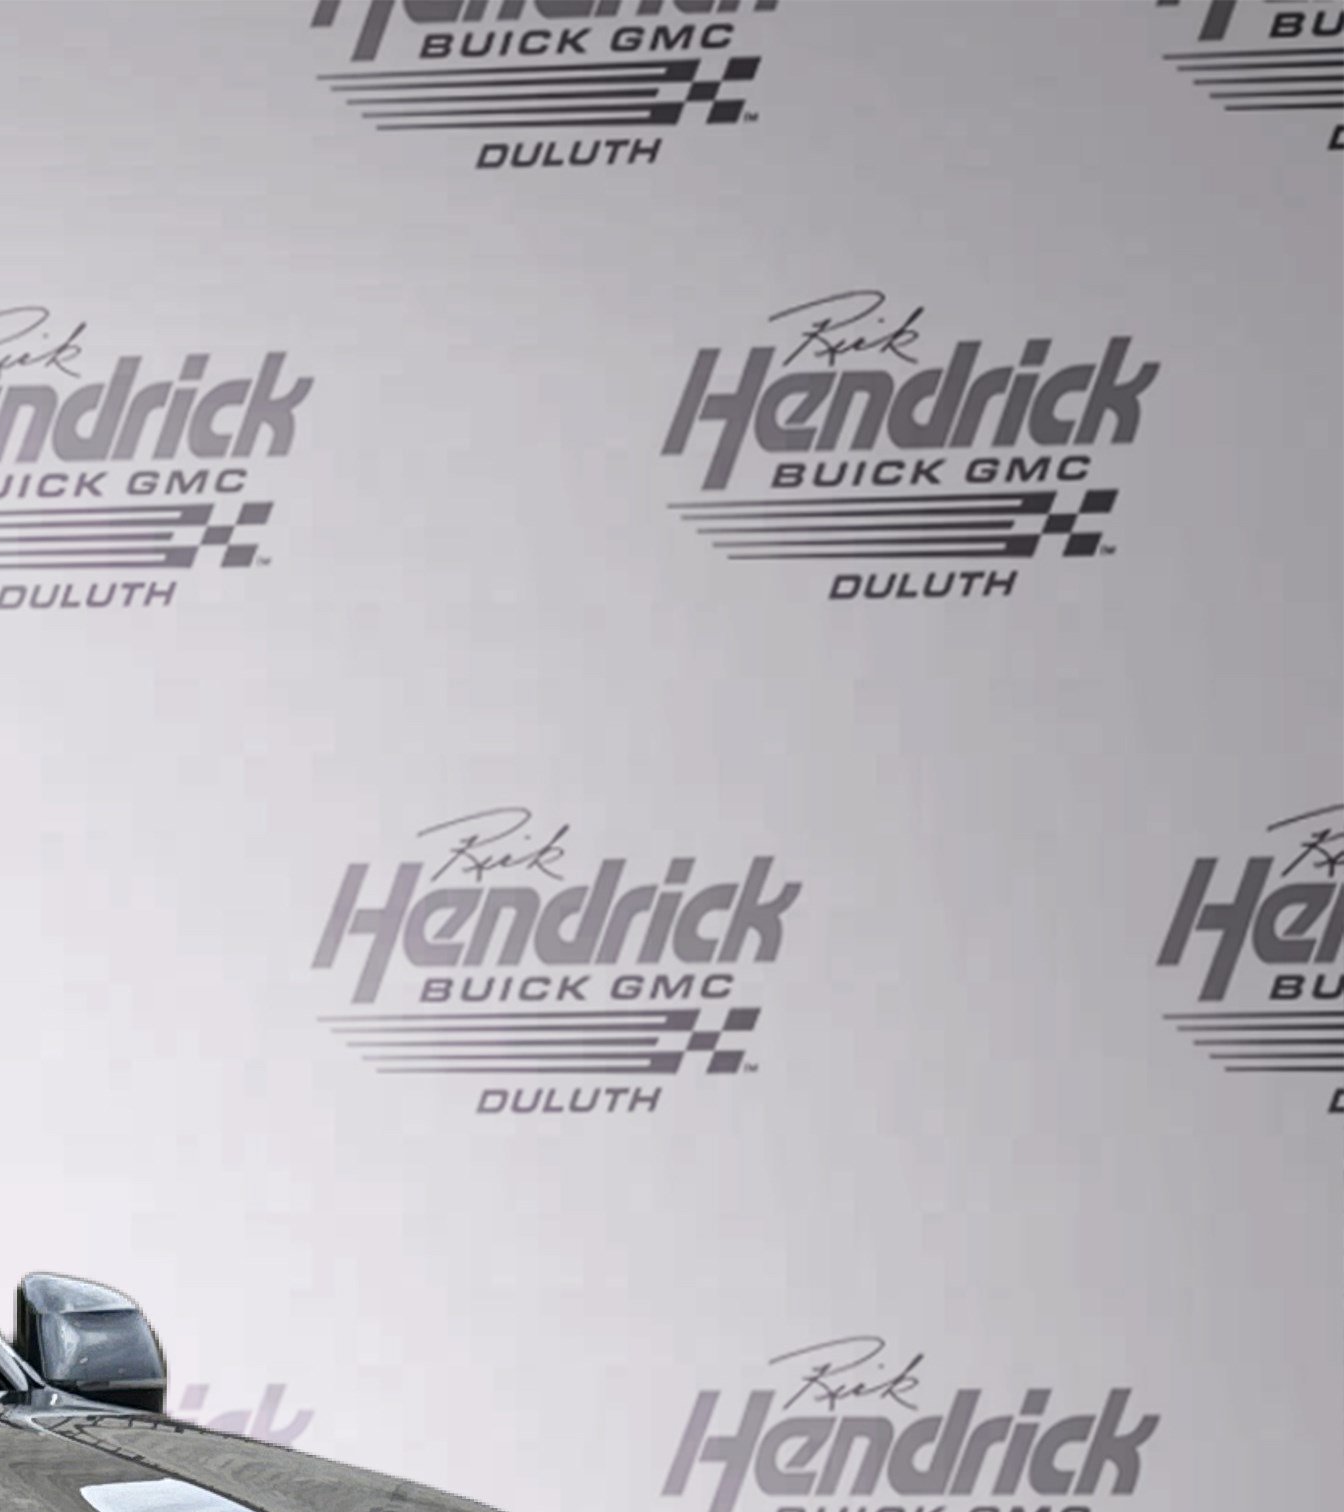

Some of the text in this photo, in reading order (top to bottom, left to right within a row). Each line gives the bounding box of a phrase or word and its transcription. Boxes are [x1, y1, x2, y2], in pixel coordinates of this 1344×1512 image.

[419, 28, 591, 59] BUICK
[610, 23, 734, 52] GMC
[476, 138, 662, 169] DULUTH
[661, 336, 1161, 491] Hendrick
[127, 468, 247, 495] GMC
[771, 455, 1091, 488] BUICK GMC
[829, 570, 1018, 600] DULUTH
[311, 856, 803, 1004] Hendrick
[420, 974, 734, 1002] BUICK GMC
[477, 1087, 662, 1113] DULUTH
